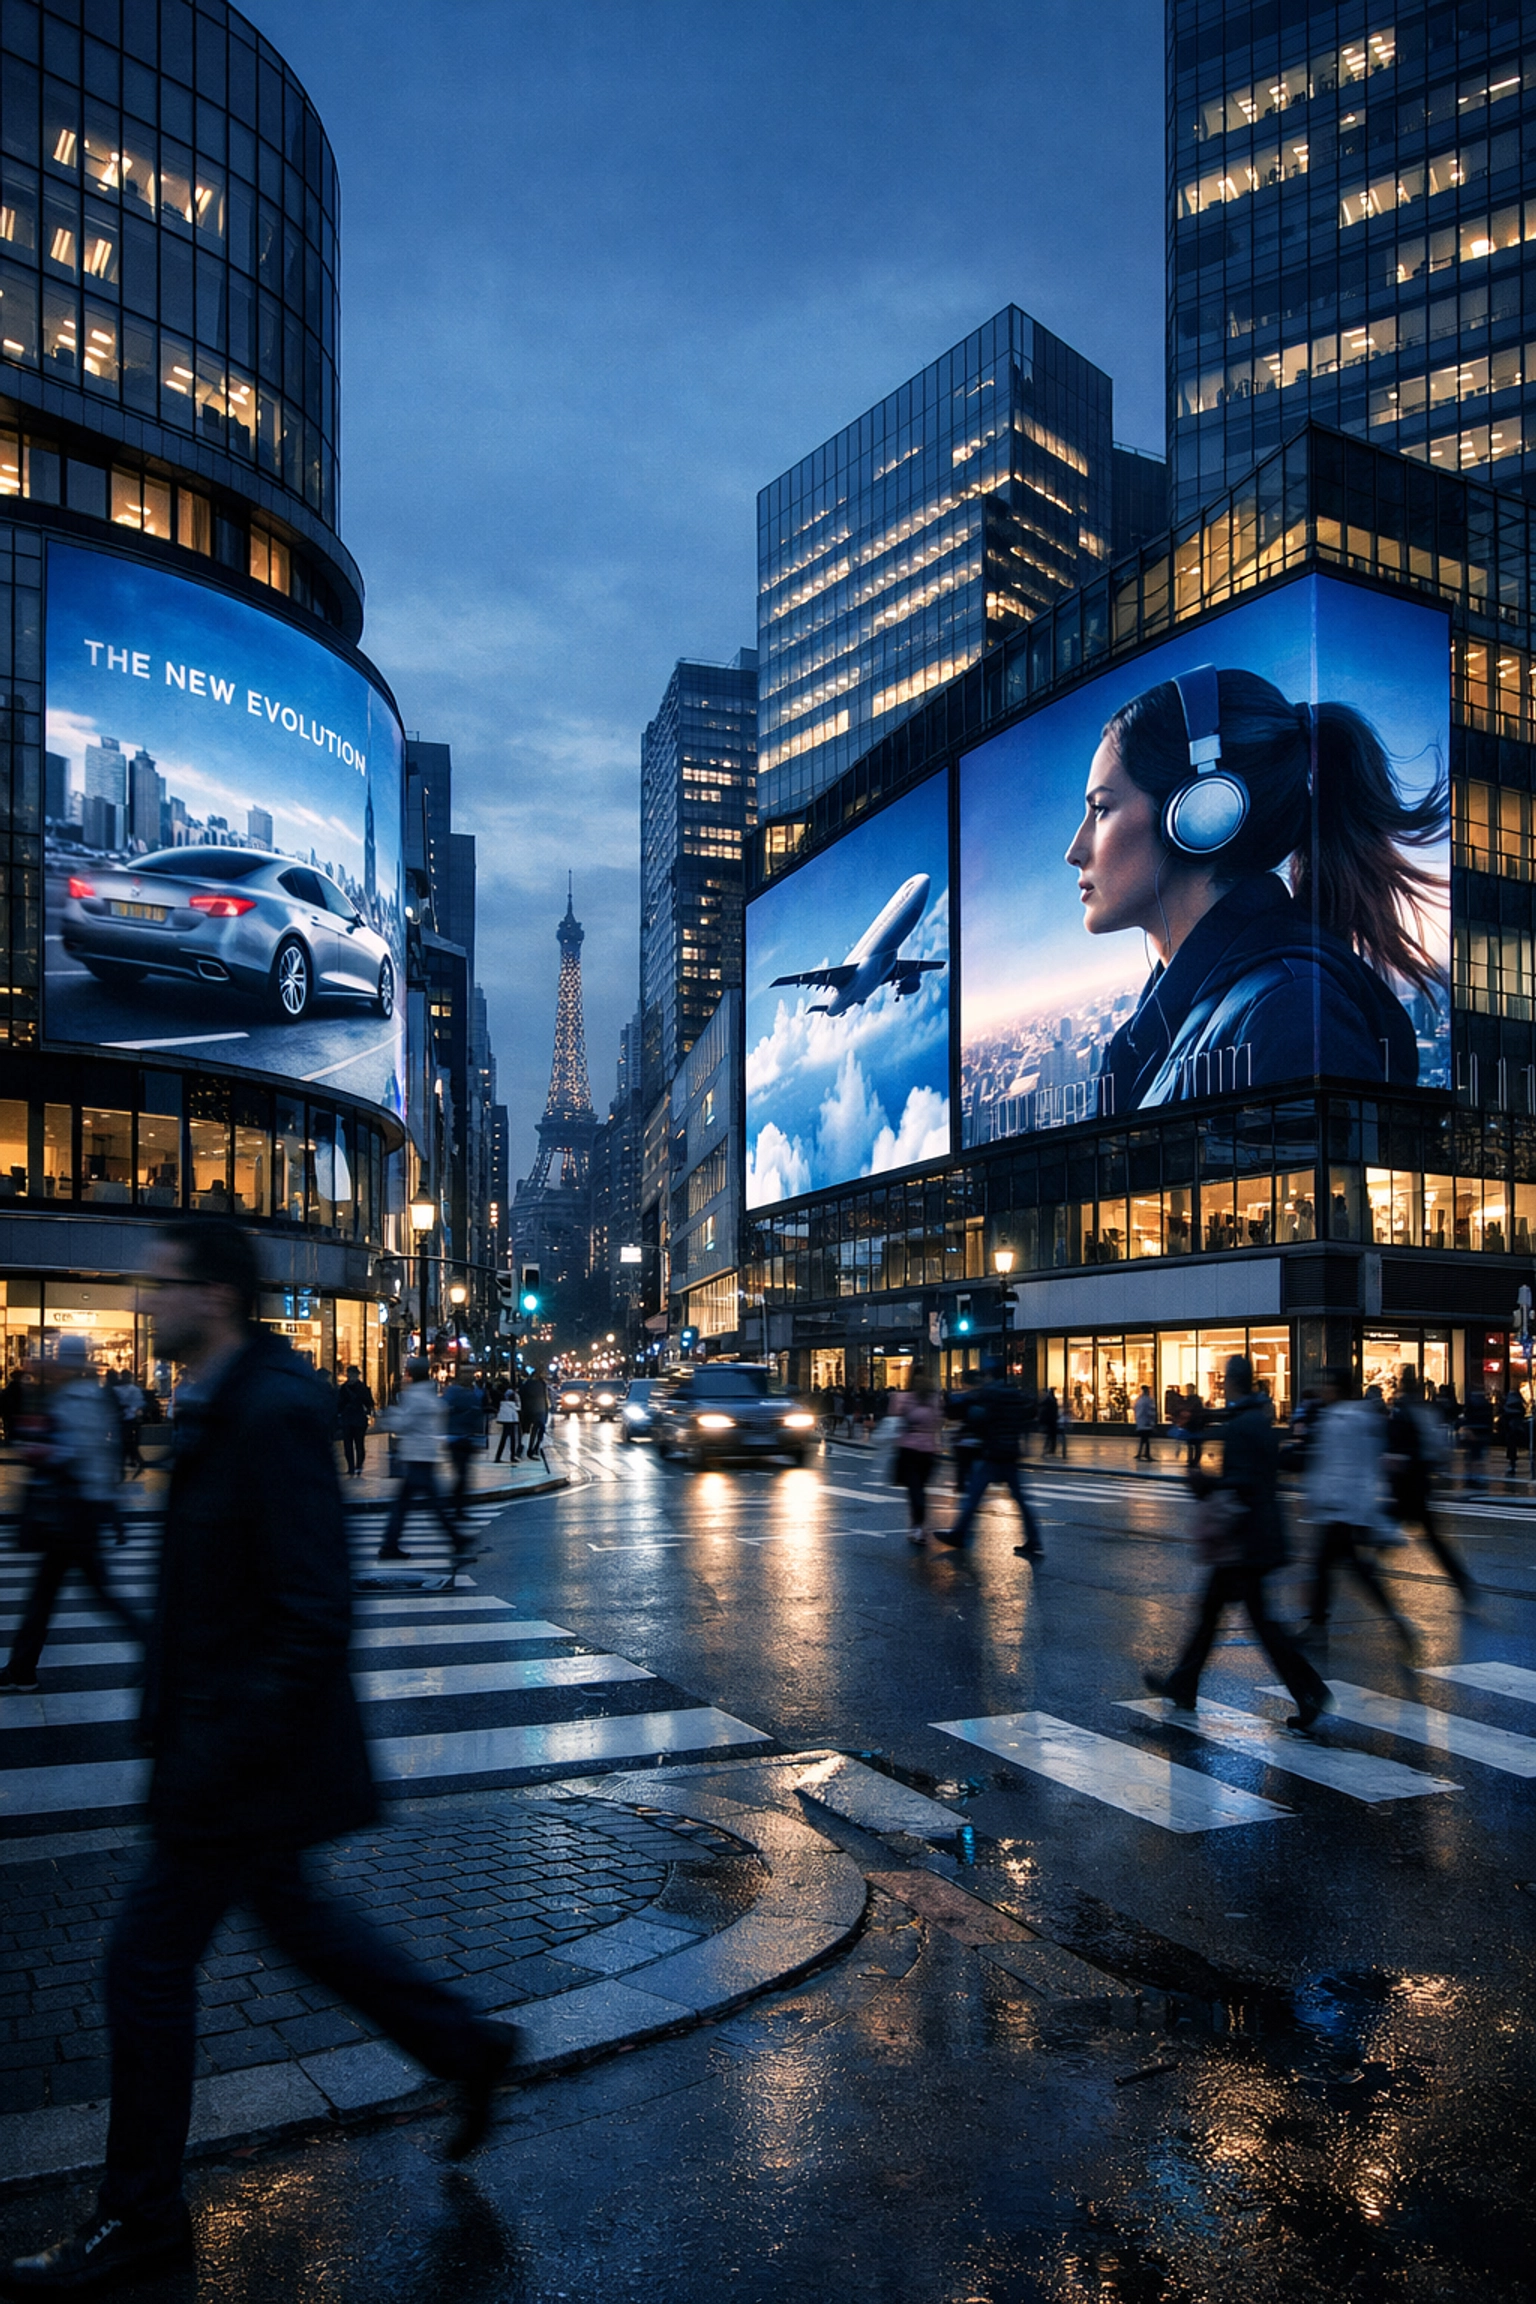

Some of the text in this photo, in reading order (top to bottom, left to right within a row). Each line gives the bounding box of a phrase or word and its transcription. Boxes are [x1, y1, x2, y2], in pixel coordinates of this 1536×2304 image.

[84, 639, 366, 777] THE NEW EVOLUTION
